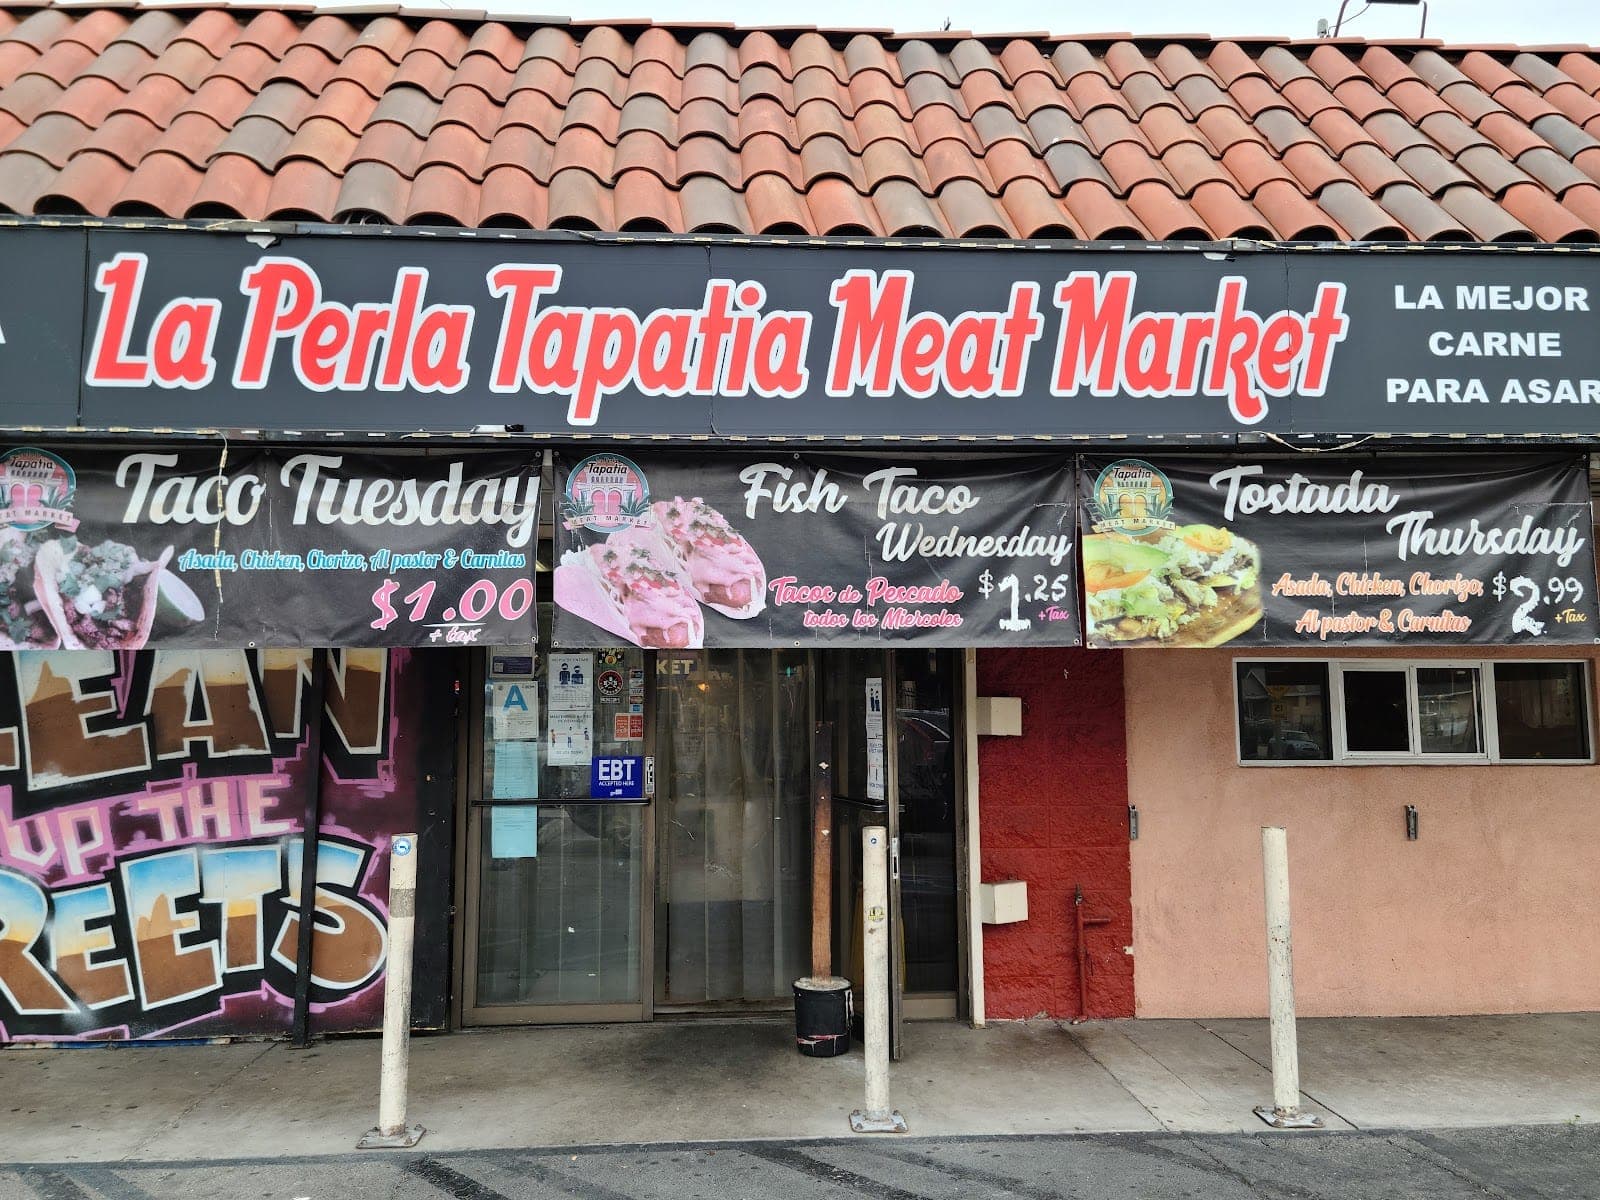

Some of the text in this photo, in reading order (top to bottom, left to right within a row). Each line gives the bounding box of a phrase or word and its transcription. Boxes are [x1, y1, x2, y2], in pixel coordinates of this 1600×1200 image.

[1395, 285, 1590, 311] LA MEJOR
[86, 252, 1349, 426] La Perla Tapatia Meat Market
[1429, 331, 1561, 357] CARNE
[1386, 378, 1600, 404] PARA ASAR
[10, 456, 53, 470] Tapatia
[588, 462, 627, 476] Tapatia
[1113, 467, 1152, 481] Tapatia
[115, 453, 540, 548] Taco Tuesday
[740, 463, 980, 520] Fish Taco
[1209, 465, 1400, 522] Tostada
[25, 509, 71, 520] MARKET
[876, 522, 1072, 567] Wednesday
[1385, 511, 1585, 567] Thursday
[178, 549, 526, 574] Asada, Chicken, Chorizo, Al pastor & Carnitas
[768, 576, 964, 605] Tacos de Pescado
[1272, 571, 1485, 603] Asada, Chicken, Chorizo,
[370, 579, 534, 630] $1.00
[803, 607, 963, 629] todos los Miercoles
[446, 626, 482, 643] tax
[1296, 609, 1472, 640] Al pastor & Carnitas
[656, 660, 695, 675] KET
[503, 684, 529, 711] A
[0, 648, 388, 790] EAN
[598, 759, 636, 781] EBT
[9, 778, 297, 875] UP THE
